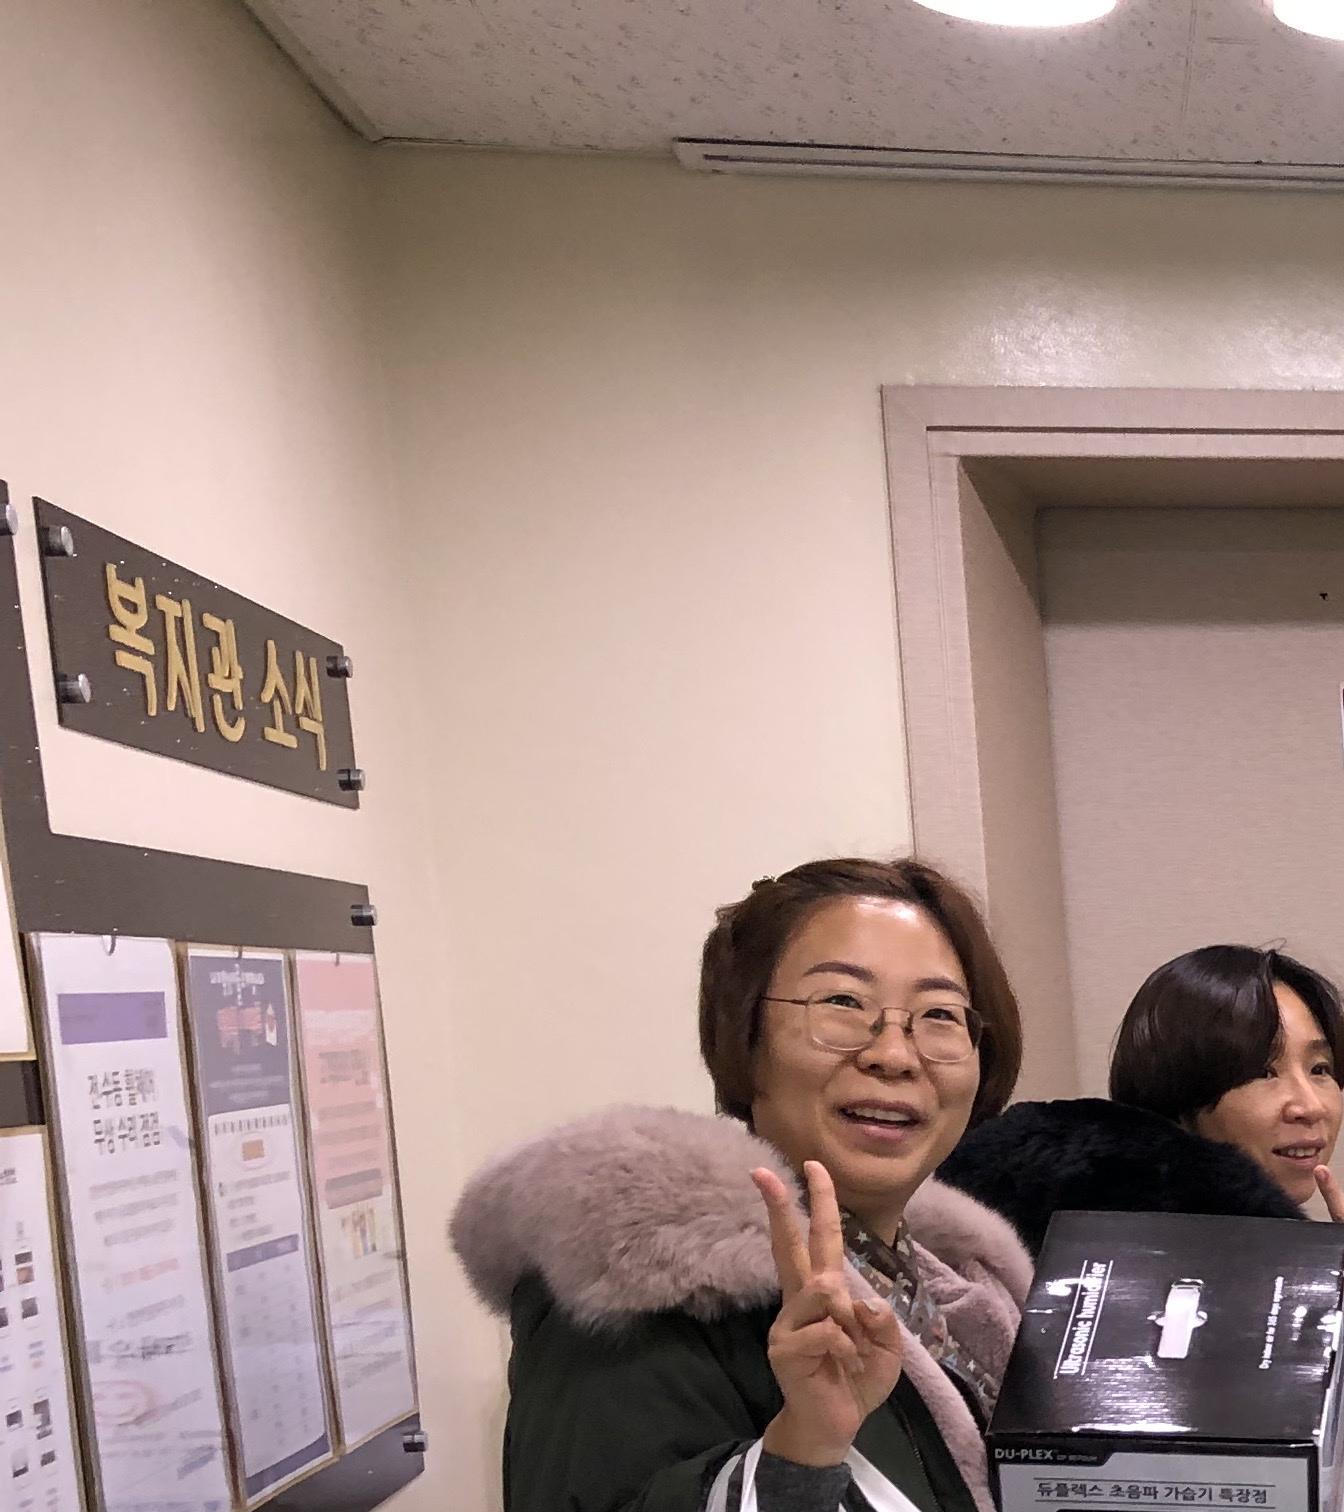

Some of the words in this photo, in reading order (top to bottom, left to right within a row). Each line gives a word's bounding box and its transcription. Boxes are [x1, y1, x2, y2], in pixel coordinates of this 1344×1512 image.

[106, 562, 246, 742] 복지관
[261, 639, 327, 771] 소식
[1059, 1320, 1092, 1374] Ultrasonic
[995, 1448, 1053, 1461] DU-PLEX
[1036, 1482, 1104, 1500] 듀플렉스
[1109, 1483, 1158, 1500] 초음파
[1164, 1485, 1213, 1502] 가습기
[1218, 1487, 1267, 1504] 특장점
